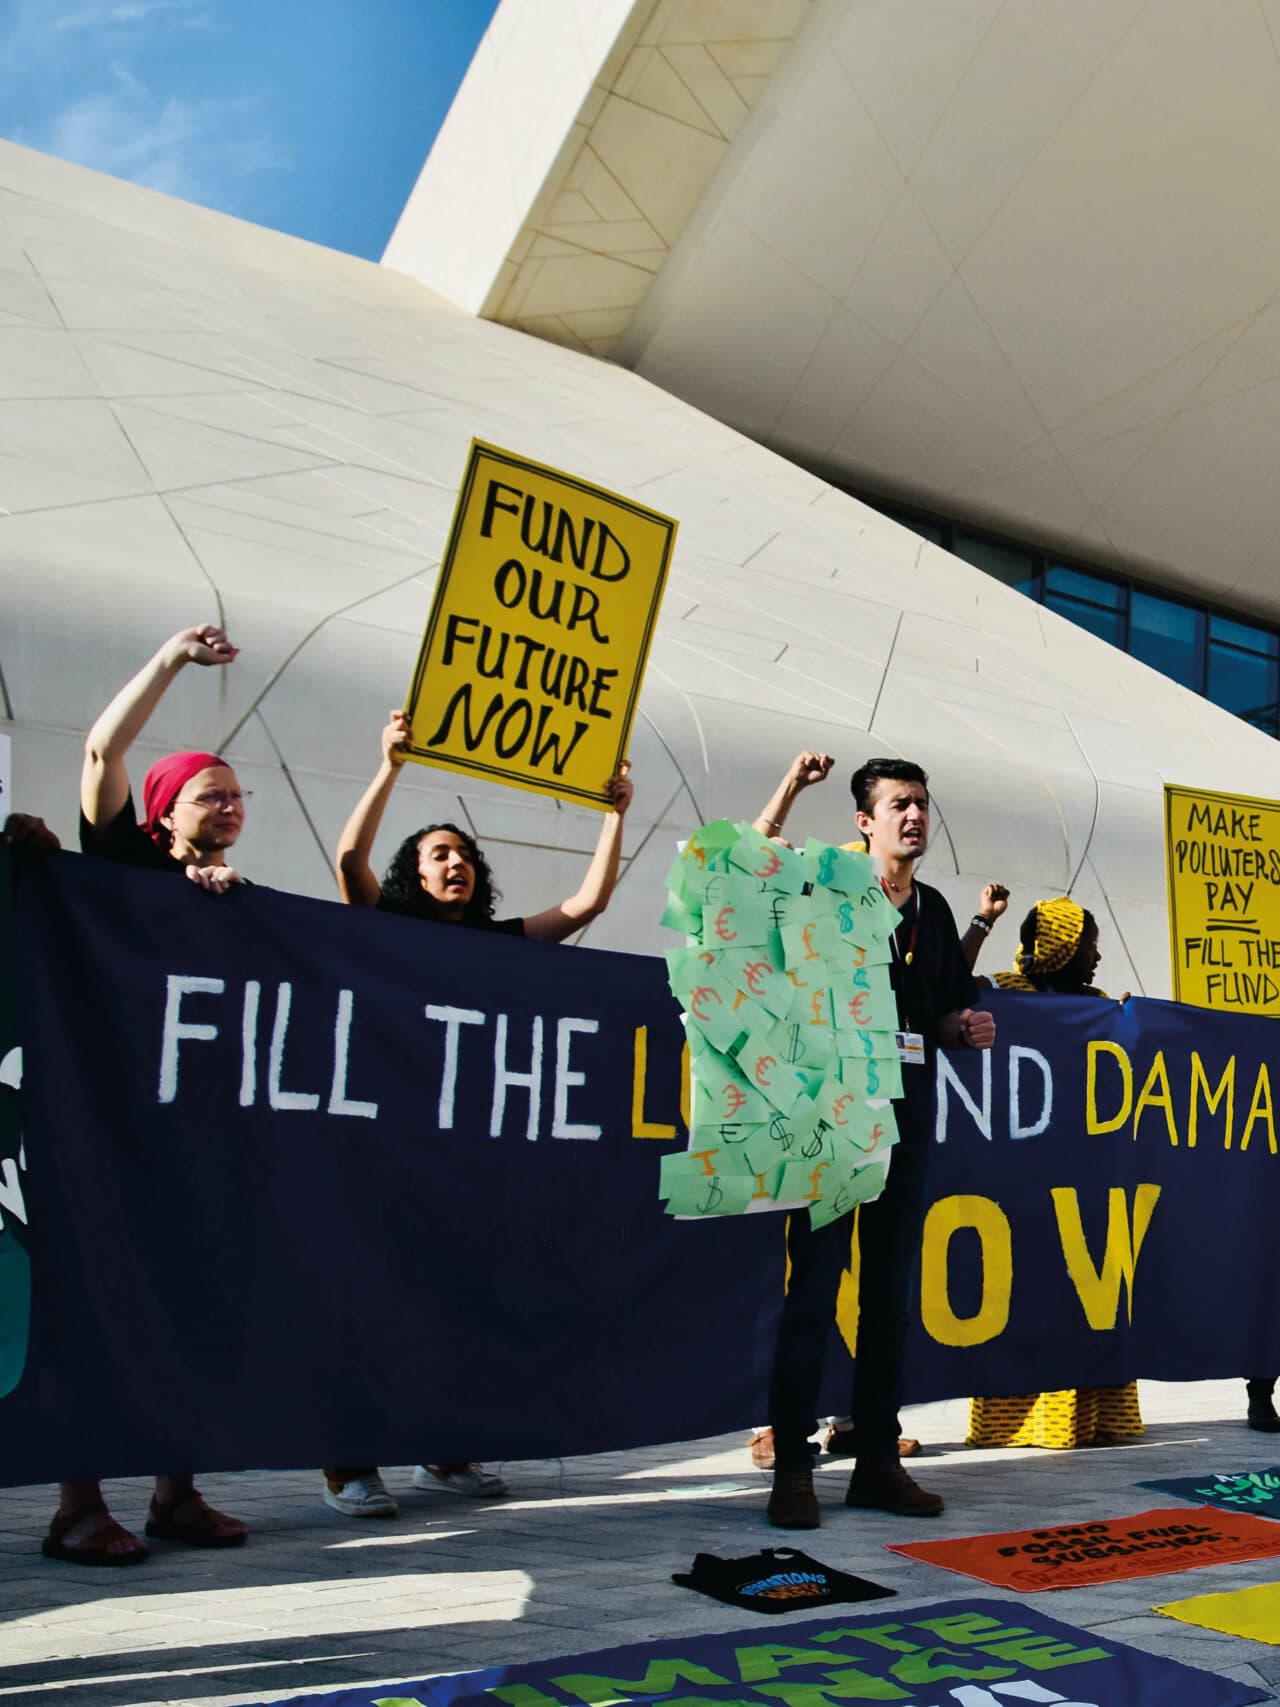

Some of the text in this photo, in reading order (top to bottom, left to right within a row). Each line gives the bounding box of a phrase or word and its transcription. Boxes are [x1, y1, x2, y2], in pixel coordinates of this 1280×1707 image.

[480, 479, 631, 582] FUND
[494, 559, 610, 644] OUR
[442, 614, 618, 720] FUTURE
[427, 683, 589, 776] NOW
[1187, 802, 1263, 842] MAKE
[1205, 880, 1254, 915] PAY
[1185, 937, 1233, 969] FILL
[1206, 972, 1280, 1006] FUND
[157, 974, 379, 1119] FILL
[425, 1004, 602, 1141] THE
[935, 1045, 1053, 1143] ND
[997, 1523, 1213, 1558] FOSSIL FUEL
[1032, 1523, 1110, 1540] END
[371, 1611, 1035, 1707] IMATE
[650, 1636, 1116, 1707] NCE
